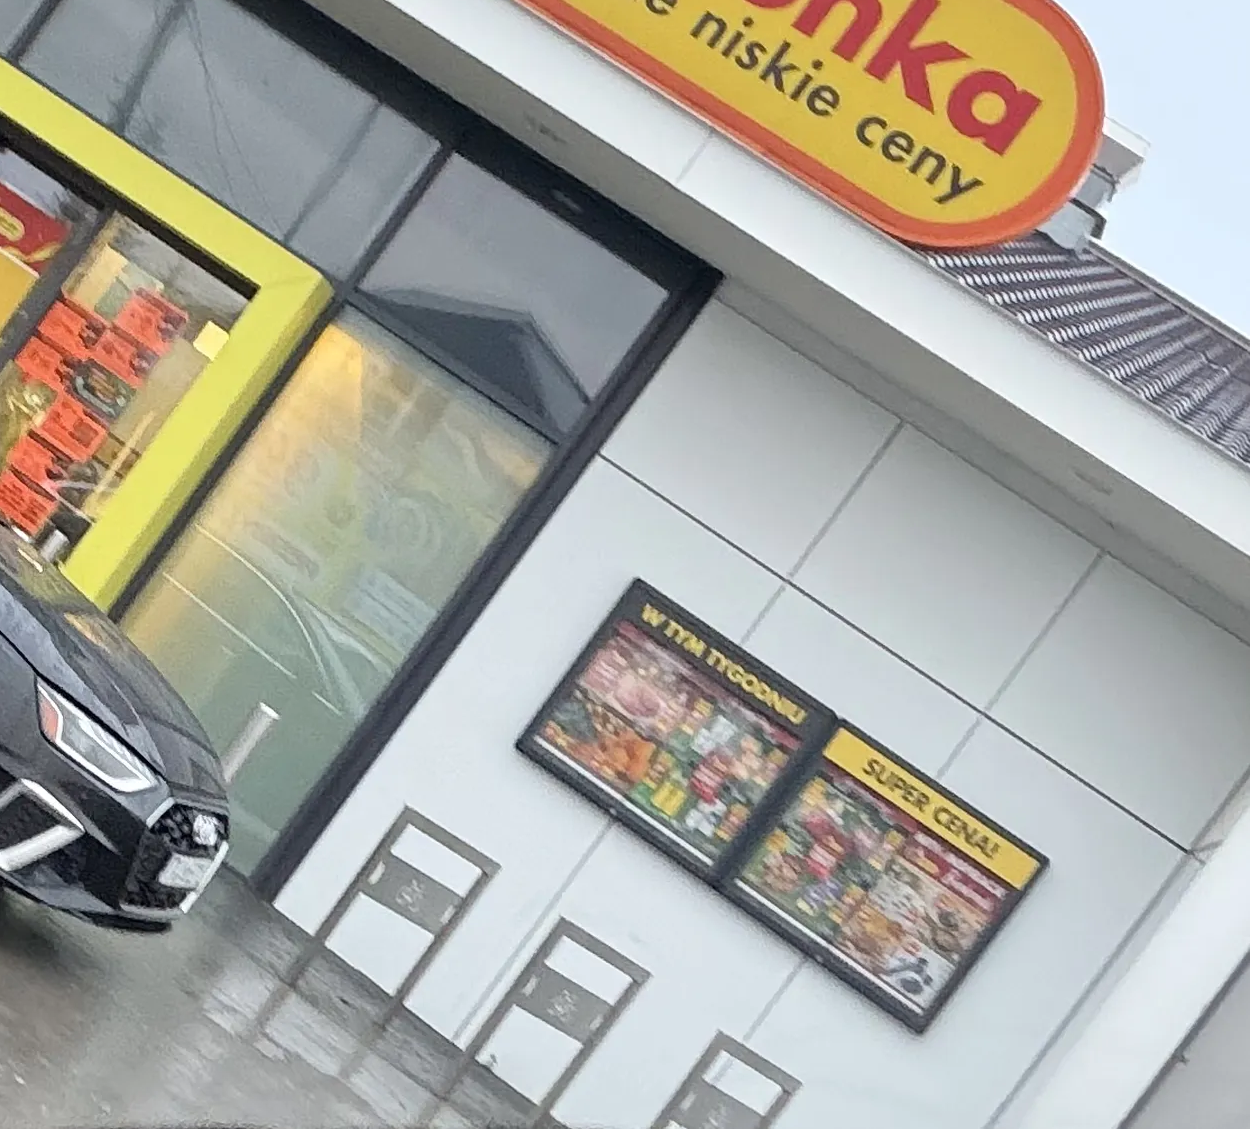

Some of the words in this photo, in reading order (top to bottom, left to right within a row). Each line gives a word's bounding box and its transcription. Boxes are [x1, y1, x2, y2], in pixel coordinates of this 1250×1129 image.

[690, 11, 839, 116] niskie
[855, 116, 985, 205] ceny
[640, 604, 664, 625] W
[664, 621, 707, 656] TYM
[705, 648, 807, 724] TYGODNIU
[862, 759, 930, 812] SUPER
[933, 807, 1000, 859] CENA!
